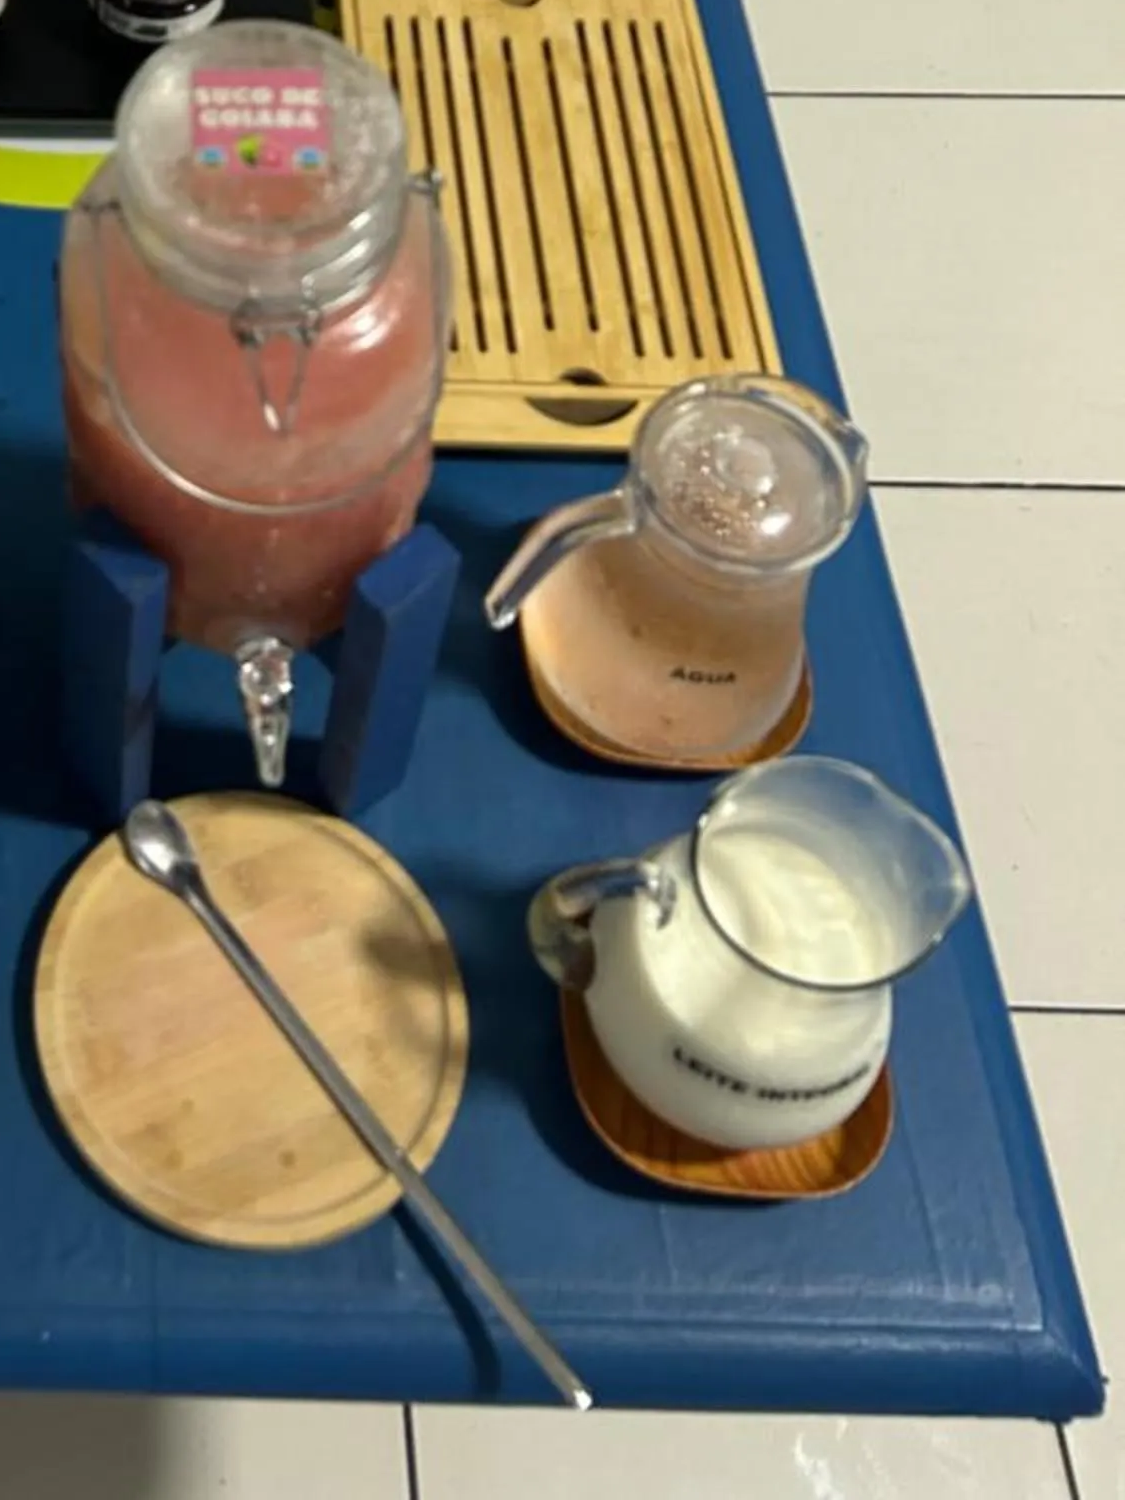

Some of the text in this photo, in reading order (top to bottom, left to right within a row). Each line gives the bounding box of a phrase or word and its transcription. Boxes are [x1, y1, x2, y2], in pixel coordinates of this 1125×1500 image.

[194, 85, 321, 106] SUCO DE
[198, 107, 318, 131] GOIABA
[673, 1045, 750, 1094] LEITE
